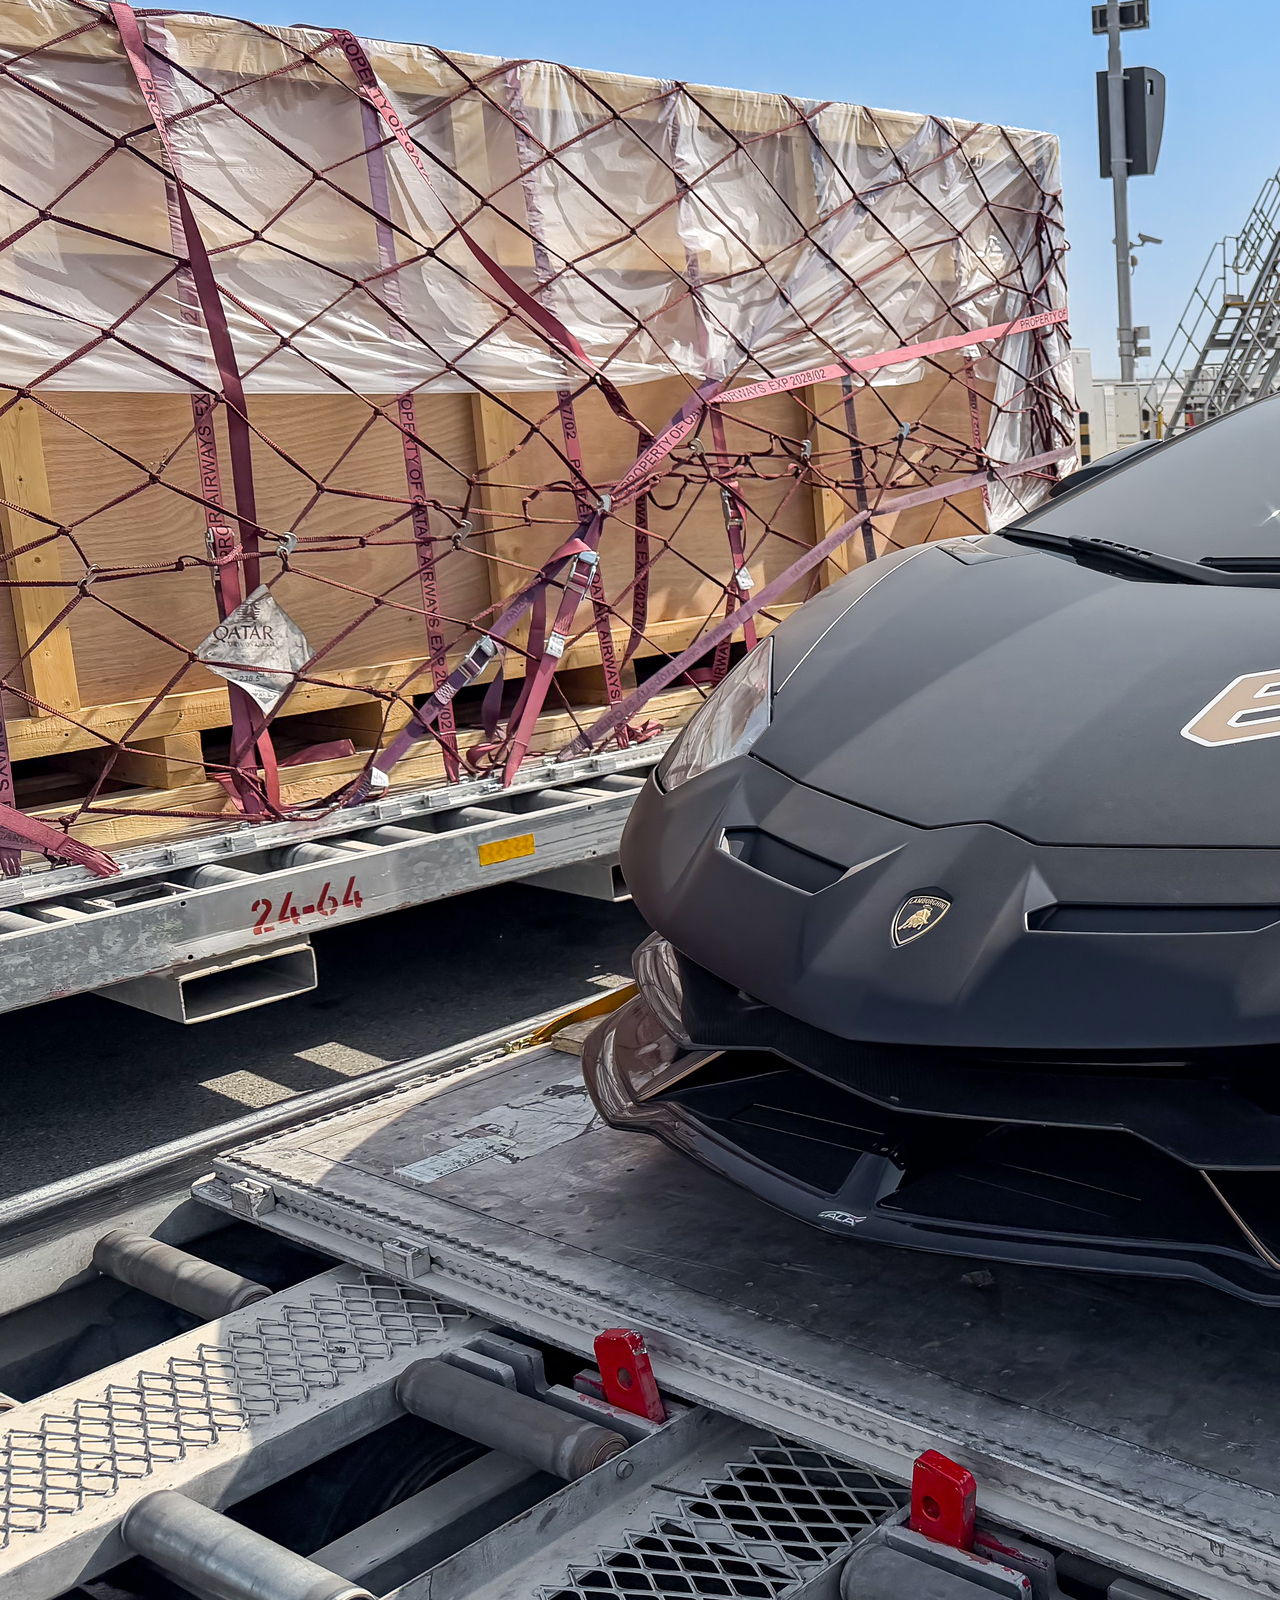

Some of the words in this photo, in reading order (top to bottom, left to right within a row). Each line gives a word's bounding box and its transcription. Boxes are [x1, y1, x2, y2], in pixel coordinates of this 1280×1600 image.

[1020, 312, 1058, 329] PROPERTY
[1057, 308, 1068, 320] OF
[768, 378, 789, 391] EXP
[791, 368, 827, 386] 2028/02
[670, 424, 685, 440] OF
[409, 469, 423, 491] OF
[213, 625, 274, 643] QATAR
[600, 630, 621, 700] AIRWAYS
[252, 876, 363, 936] 24-64
